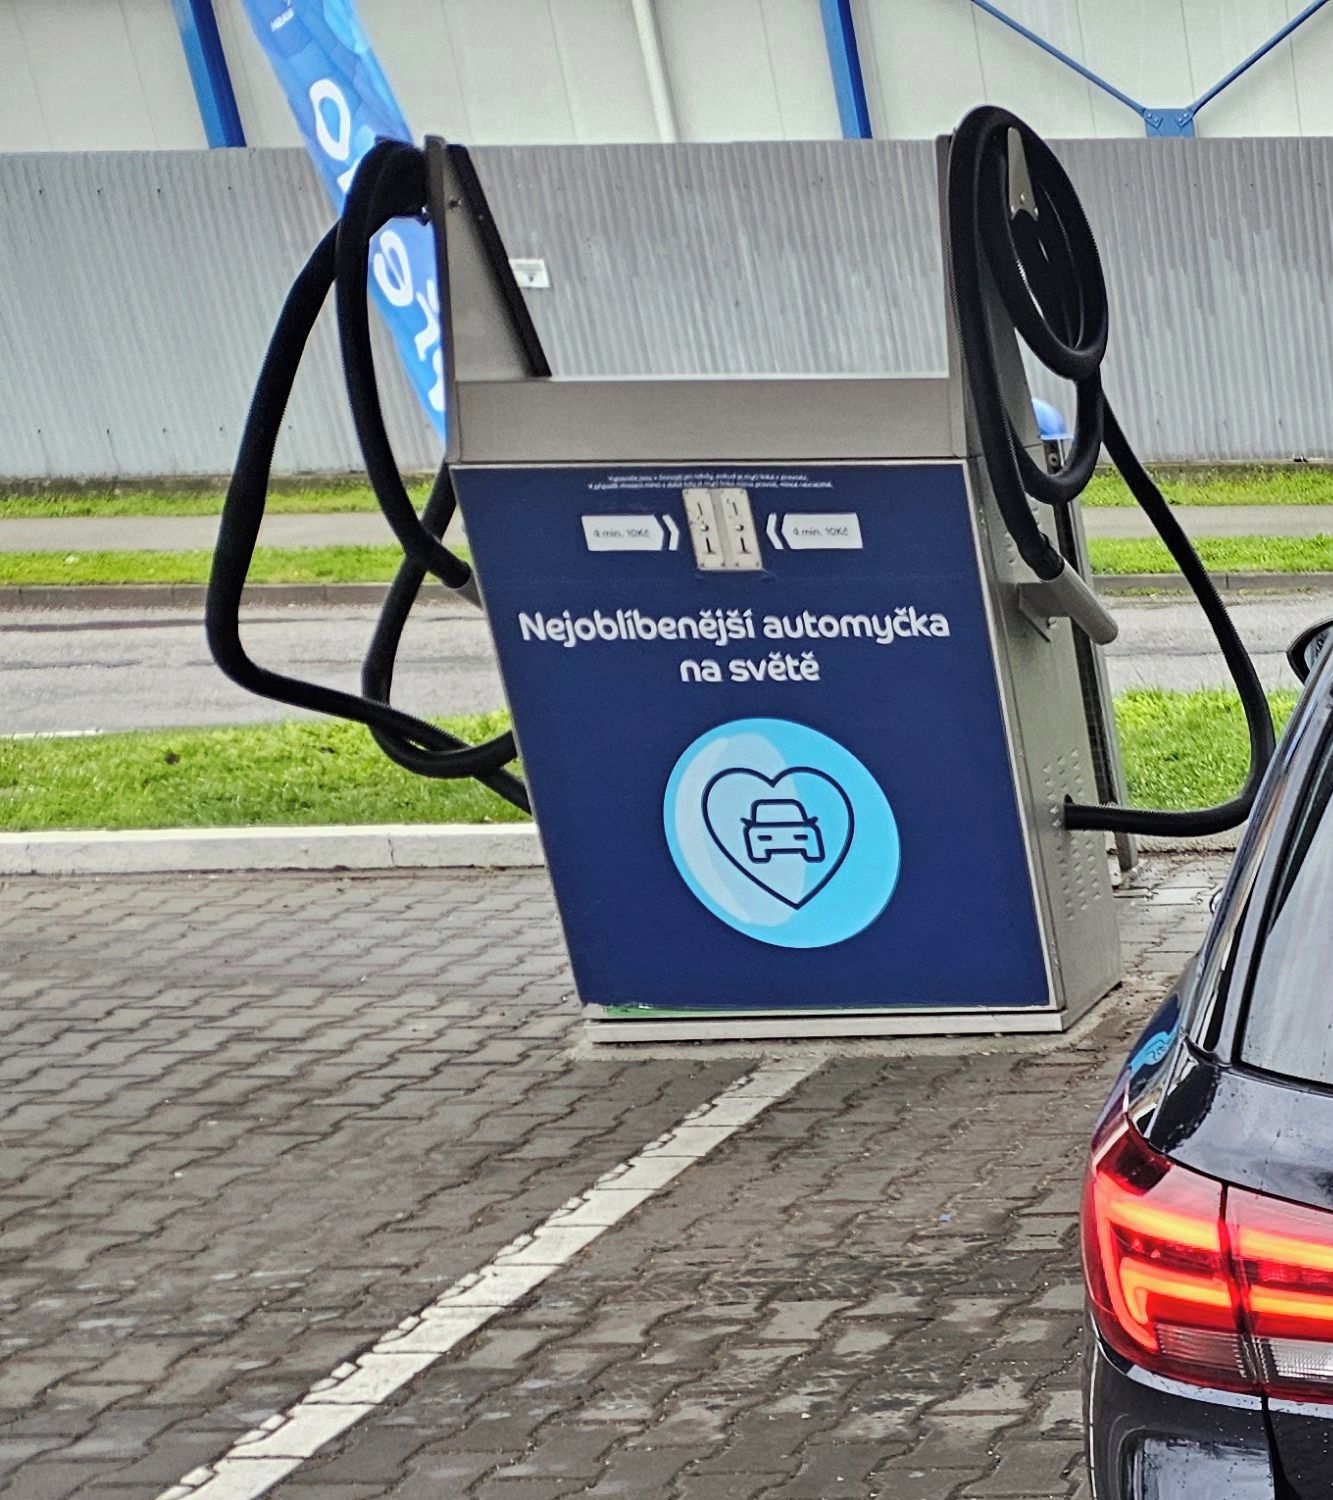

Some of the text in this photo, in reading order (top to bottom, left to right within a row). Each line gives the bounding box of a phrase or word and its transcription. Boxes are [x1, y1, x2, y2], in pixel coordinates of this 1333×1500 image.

[518, 606, 951, 648] Nejoblíbenější automyčka
[679, 651, 821, 683] na světě
